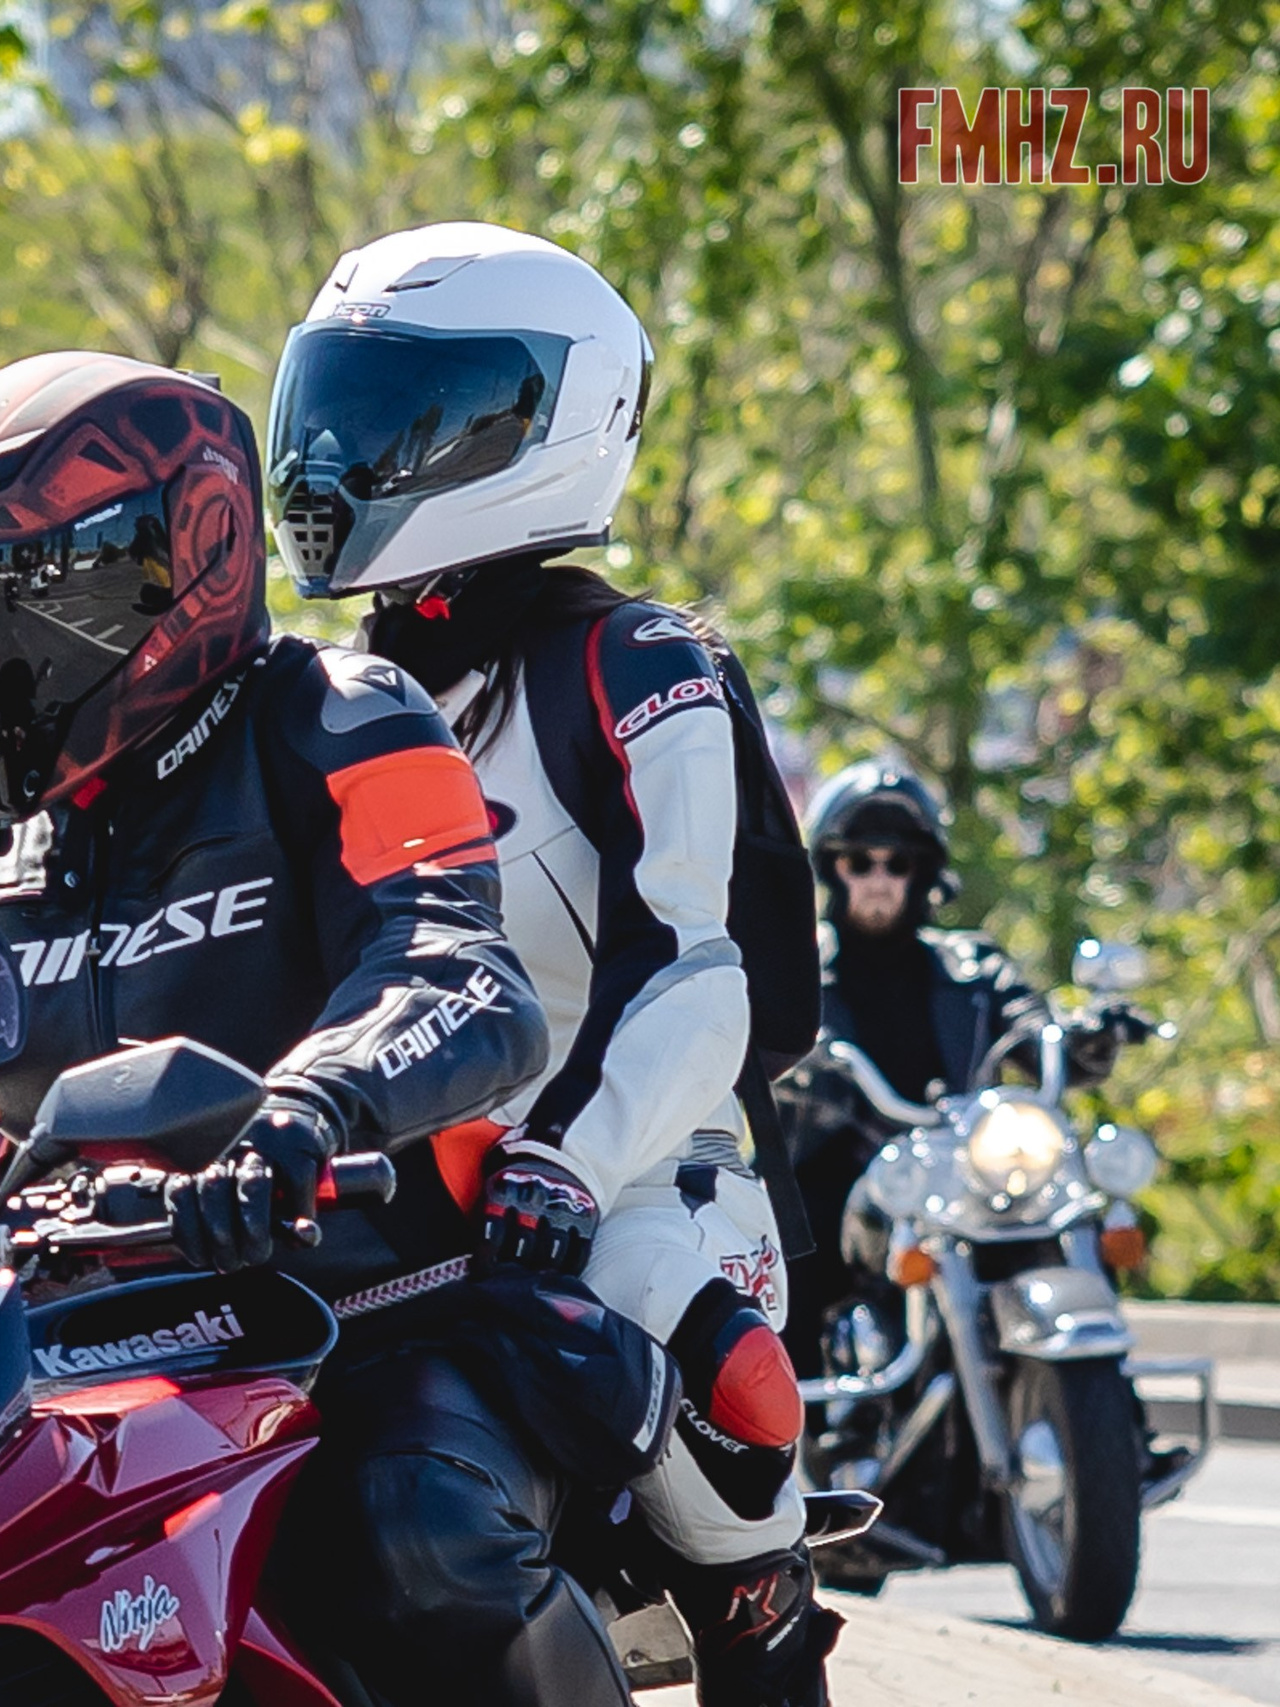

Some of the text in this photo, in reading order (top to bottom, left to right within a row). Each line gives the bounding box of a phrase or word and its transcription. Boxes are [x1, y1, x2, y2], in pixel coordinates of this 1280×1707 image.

[157, 670, 248, 780] DAINES
[375, 965, 502, 1080] DAINESE
[33, 1304, 245, 1377] Kawasaki
[100, 1574, 180, 1653] Ninja
